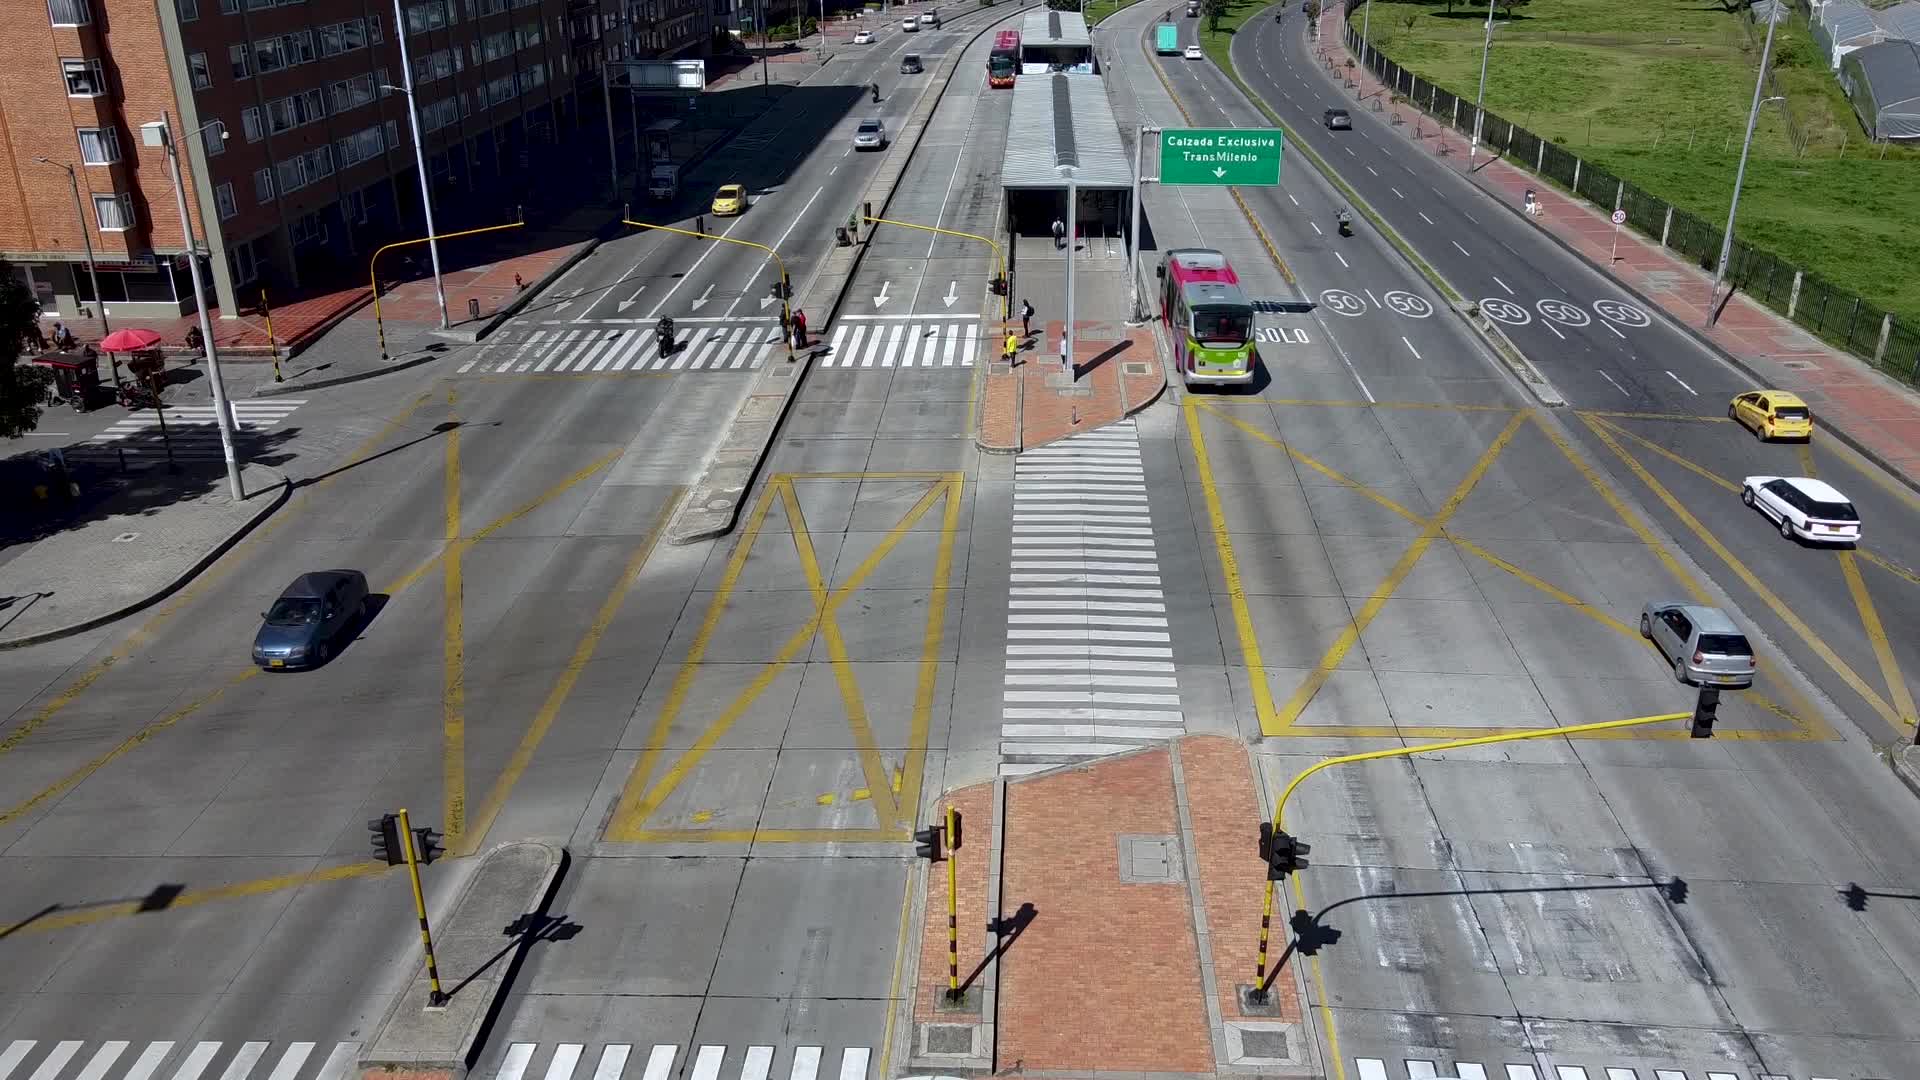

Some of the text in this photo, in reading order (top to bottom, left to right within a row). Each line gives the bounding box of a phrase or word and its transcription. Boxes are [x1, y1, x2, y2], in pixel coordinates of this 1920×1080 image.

[1167, 136, 1275, 147] Calzada Exclusiva
[1183, 151, 1258, 162] TransMilenio
[1614, 213, 1625, 221] 50
[1327, 295, 1359, 310] 50
[1390, 297, 1425, 312] 50
[1485, 303, 1523, 319] 50
[1543, 304, 1582, 320] 50
[1601, 306, 1642, 321] 50
[1255, 327, 1310, 344] SOLO
